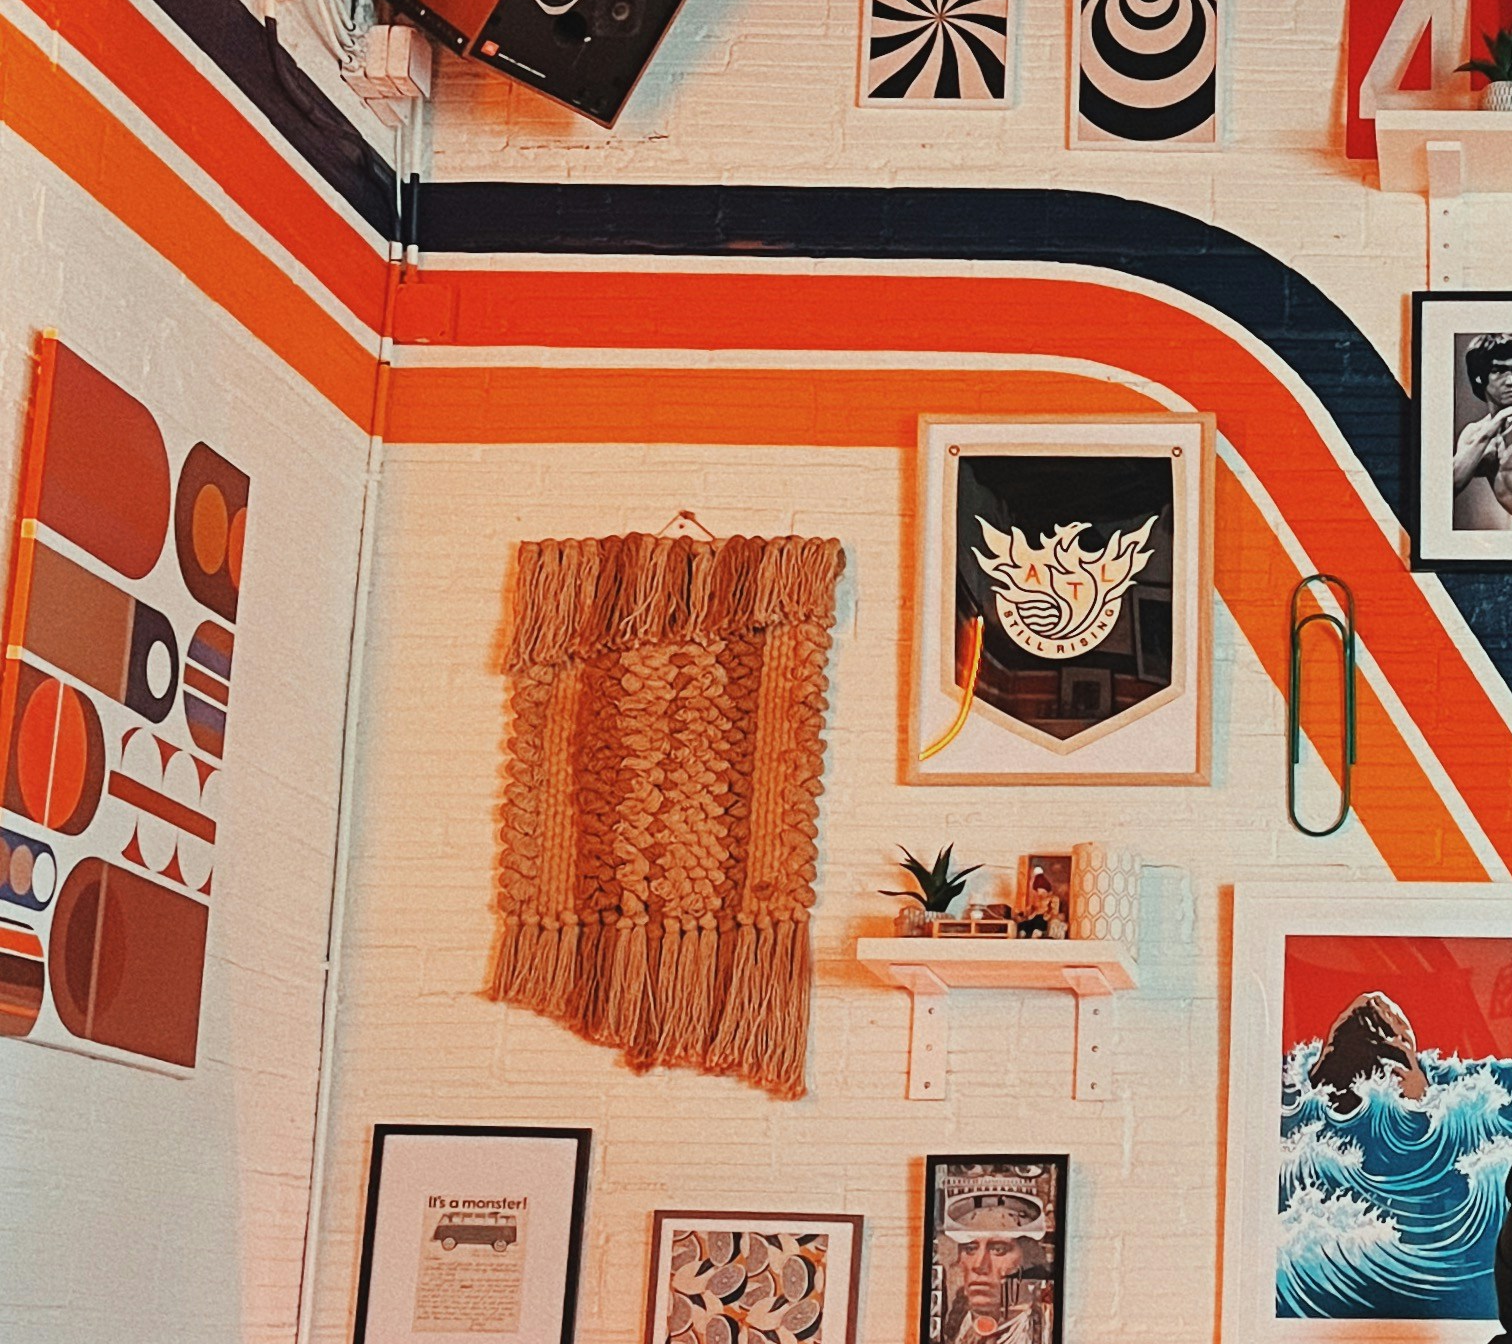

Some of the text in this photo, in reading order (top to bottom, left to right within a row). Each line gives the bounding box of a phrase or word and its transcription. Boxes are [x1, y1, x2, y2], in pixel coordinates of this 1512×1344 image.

[1003, 608, 1115, 654] STILL RISING
[428, 1195, 528, 1210] It's a monster!
